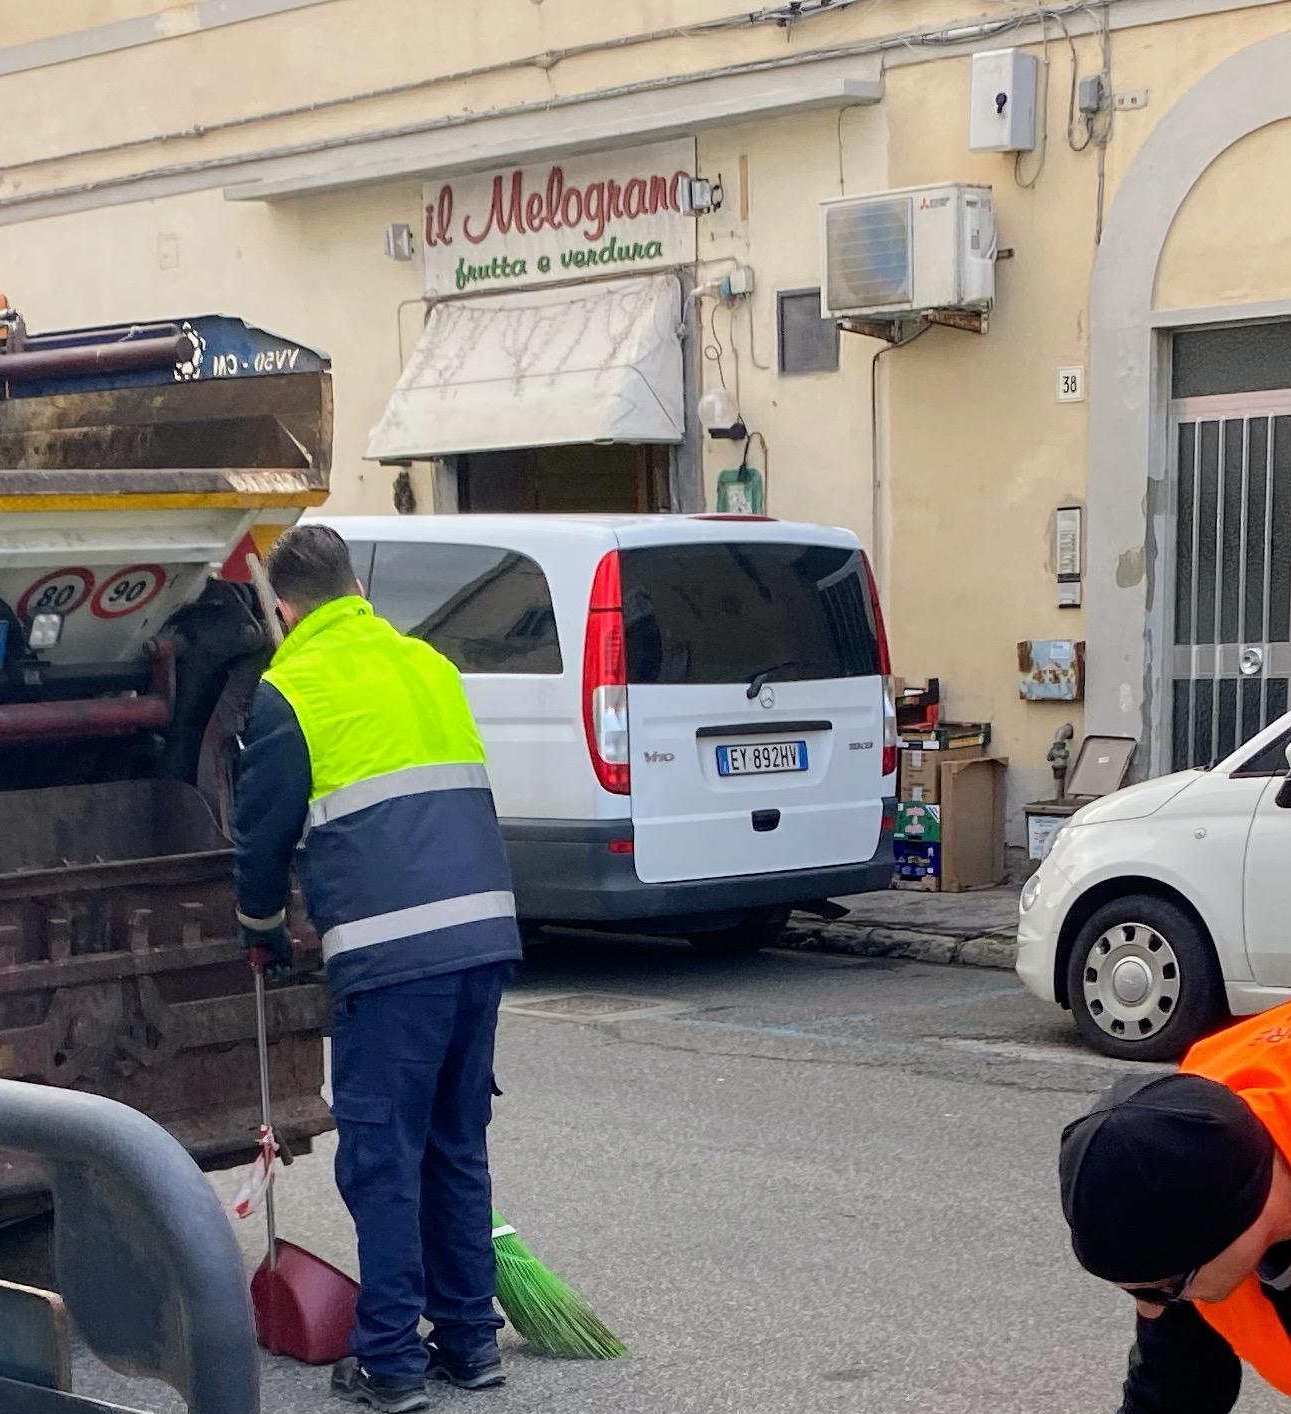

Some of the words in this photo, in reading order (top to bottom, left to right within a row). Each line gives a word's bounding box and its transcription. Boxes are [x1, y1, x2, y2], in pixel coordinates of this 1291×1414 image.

[425, 184, 454, 246] il
[455, 256, 526, 290] frutta
[537, 255, 551, 272] e
[560, 237, 663, 269] verdura
[1062, 375, 1078, 394] 38
[41, 584, 75, 608] 80
[108, 580, 147, 603] 90
[730, 748, 748, 771] EY
[753, 744, 798, 770] 892HV
